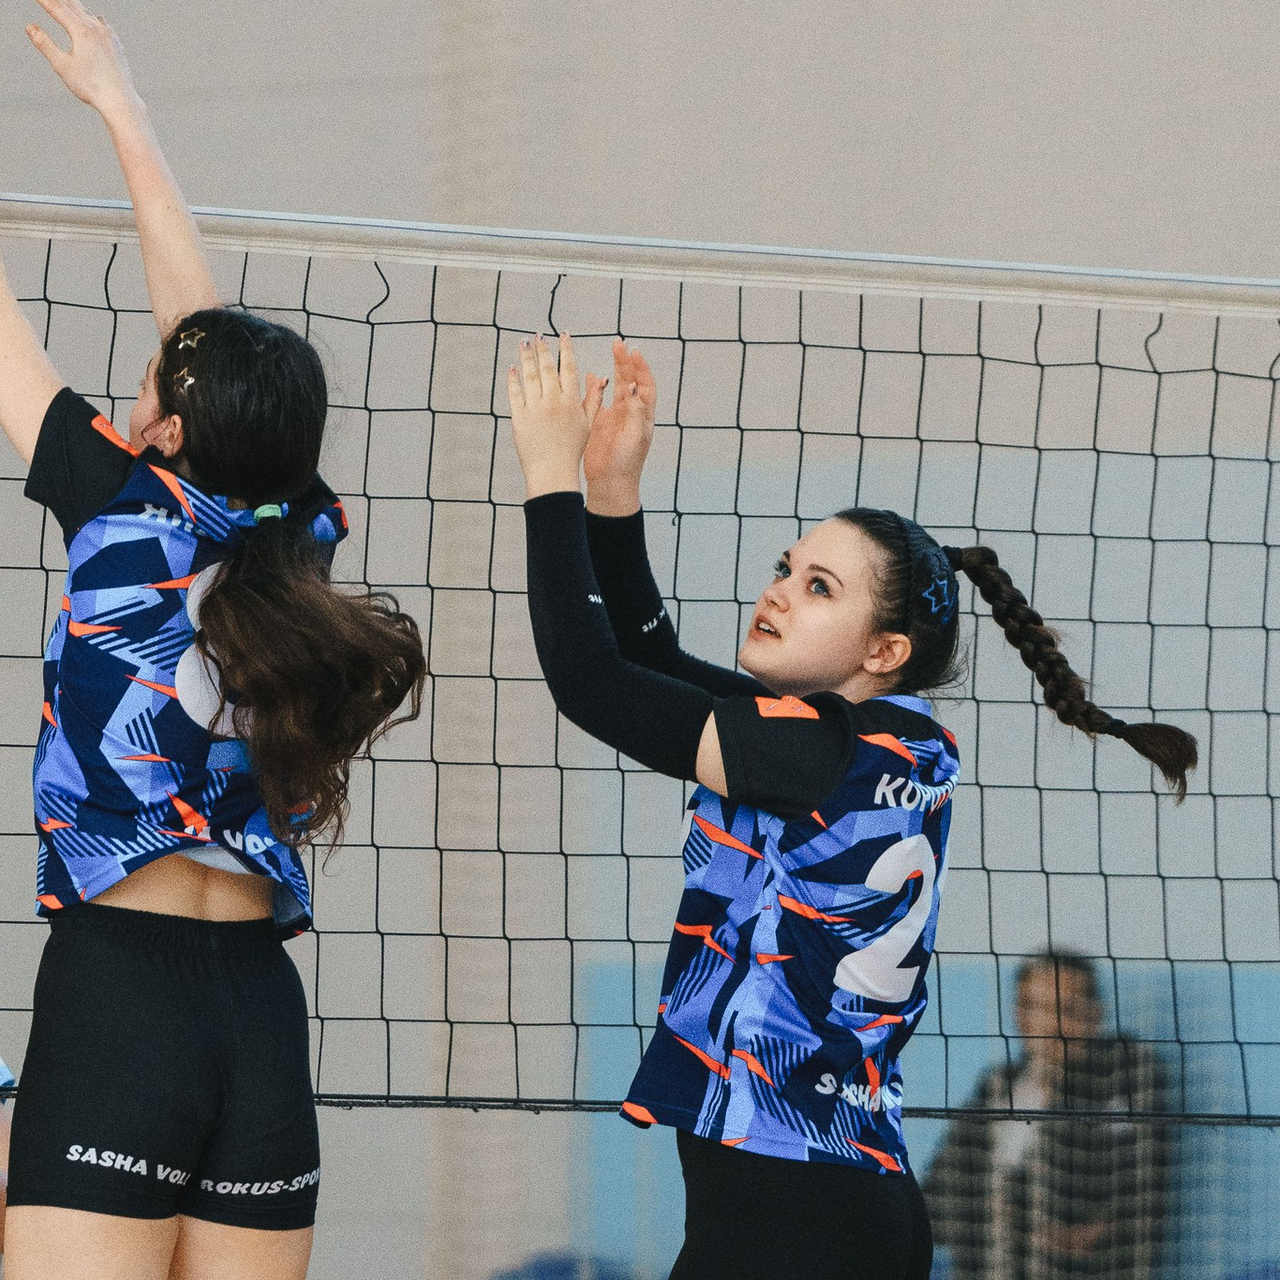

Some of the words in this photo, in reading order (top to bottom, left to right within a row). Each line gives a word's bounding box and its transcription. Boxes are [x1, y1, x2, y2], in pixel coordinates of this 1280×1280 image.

[833, 833, 937, 1003] 2
[66, 1144, 148, 1176] SASHA
[156, 1163, 192, 1186] VOLL
